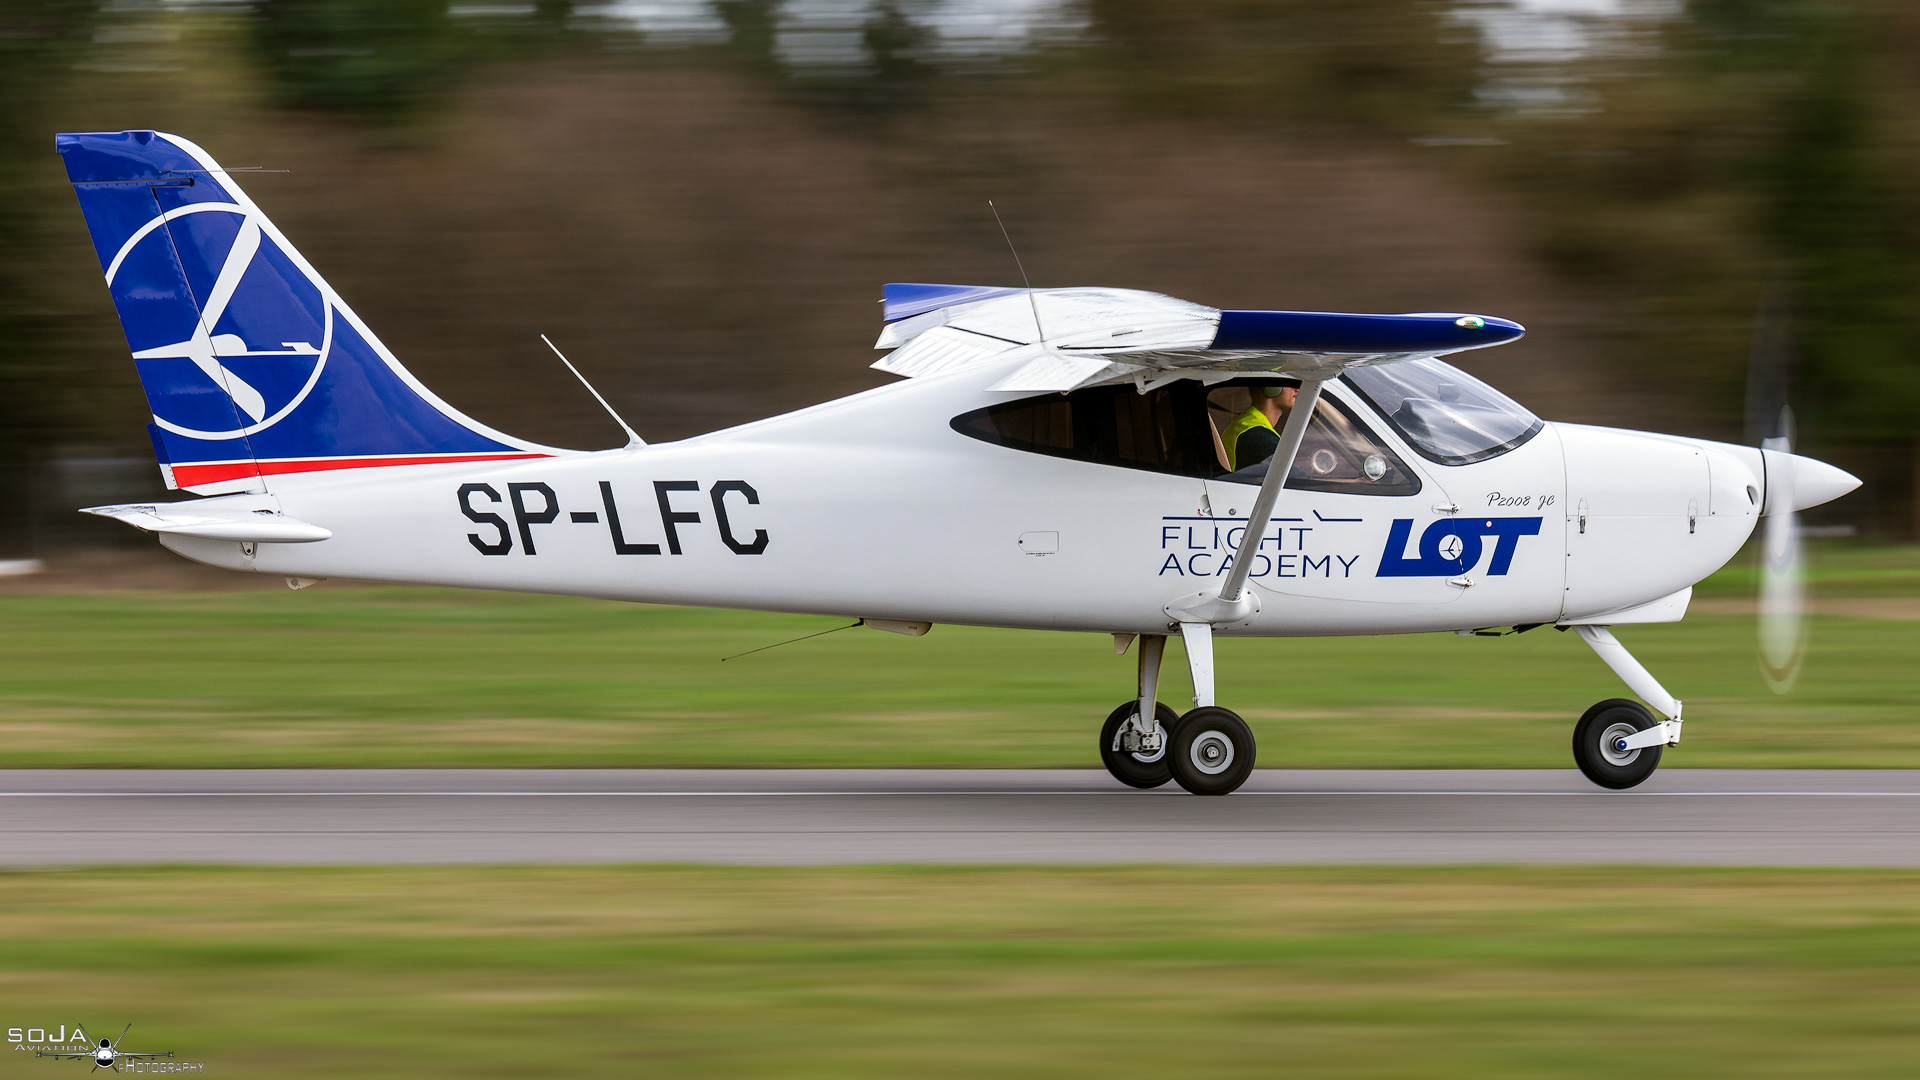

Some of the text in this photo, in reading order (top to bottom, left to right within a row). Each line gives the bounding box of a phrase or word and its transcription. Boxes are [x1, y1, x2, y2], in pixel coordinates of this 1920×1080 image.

[1486, 491, 1556, 510] P2008 JC
[456, 479, 770, 556] SP-LFC
[1161, 526, 1314, 551] FLIGHT
[1375, 516, 1544, 578] LOT
[1158, 553, 1361, 578] ACADEMY
